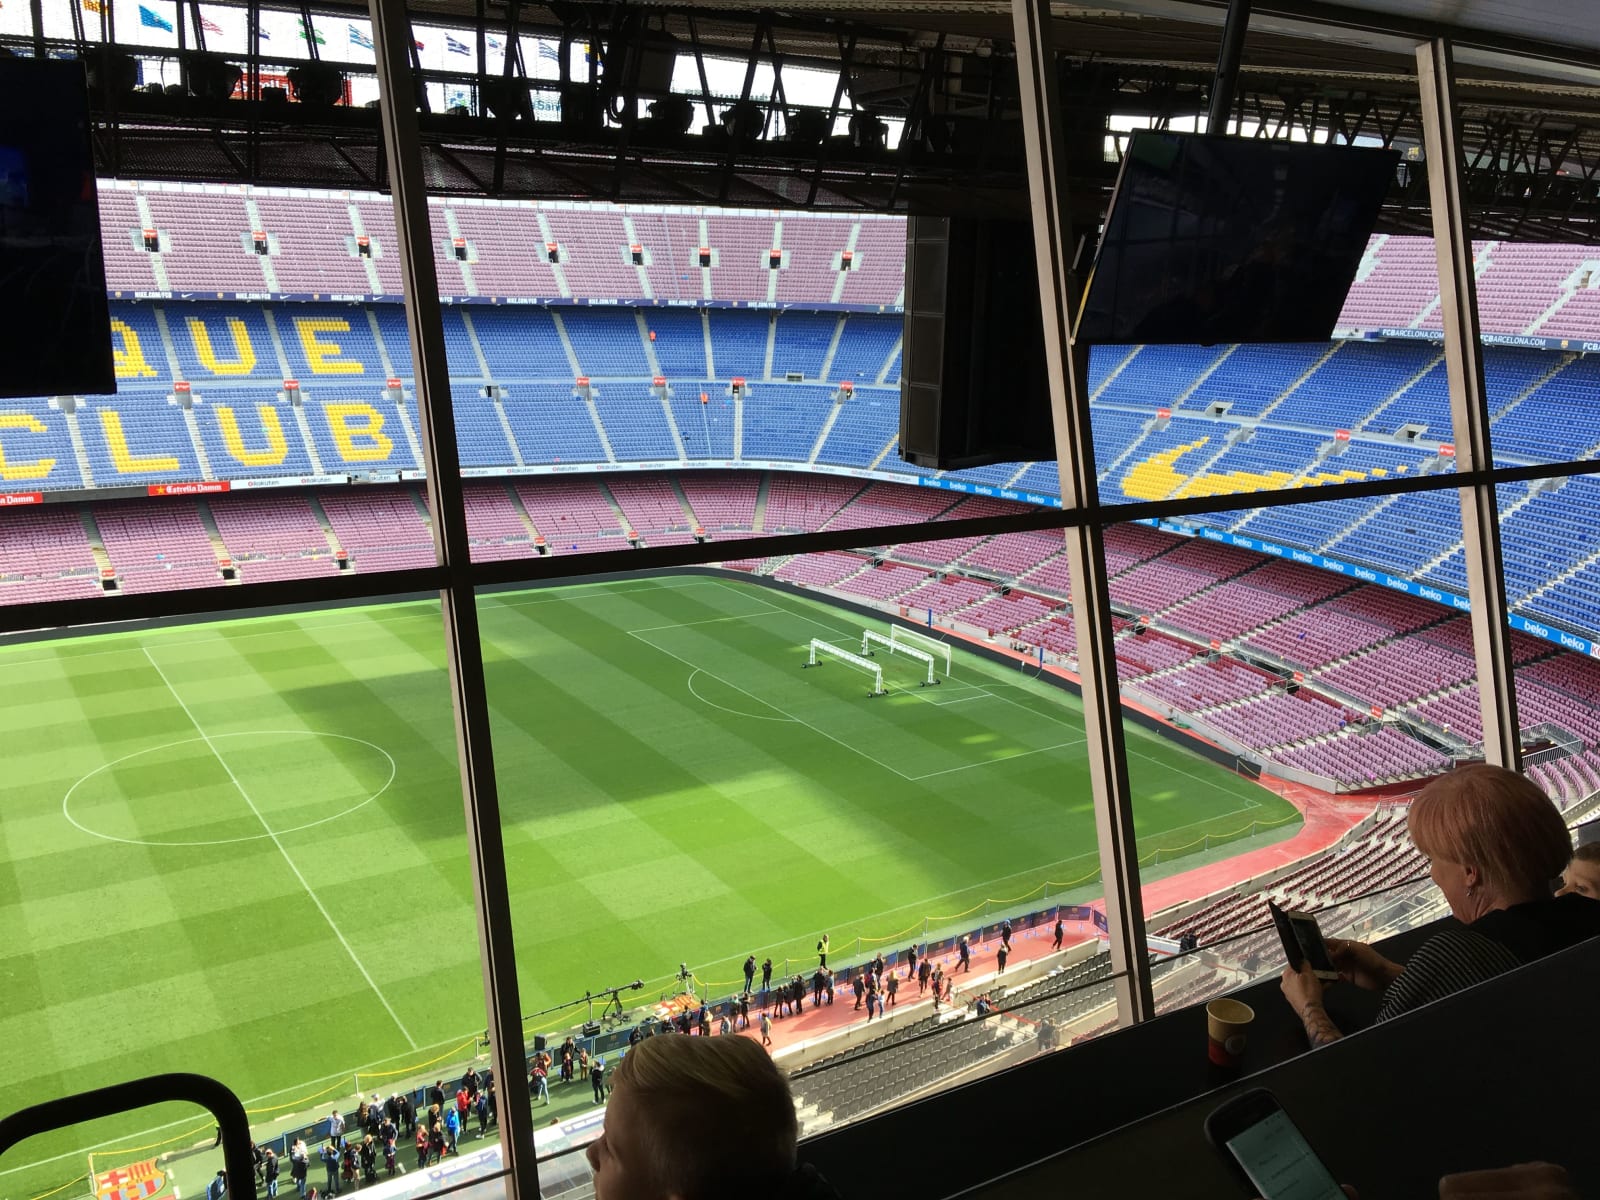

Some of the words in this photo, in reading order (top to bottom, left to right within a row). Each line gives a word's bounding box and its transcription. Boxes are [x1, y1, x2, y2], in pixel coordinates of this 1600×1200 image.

[1382, 329, 1444, 339] FCBARCELONA.COM
[1480, 334, 1546, 346] FCBARCELONA.COM
[166, 484, 196, 494] Estrella
[198, 483, 222, 492] Damm
[924, 478, 941, 487] beko
[949, 482, 967, 491] beko
[975, 486, 992, 495] beko
[1001, 489, 1018, 499] beko
[1027, 494, 1044, 504] beko
[6, 495, 34, 505] Damm
[1204, 528, 1223, 540] beko
[1233, 535, 1253, 547] beko
[1262, 543, 1282, 555] beko
[1292, 551, 1313, 563] beko
[1323, 558, 1344, 571] beko
[1354, 567, 1376, 580] beko
[1387, 576, 1409, 590] beko
[1419, 586, 1442, 600] beko
[1524, 620, 1548, 637] beko
[1560, 633, 1584, 650] beko
